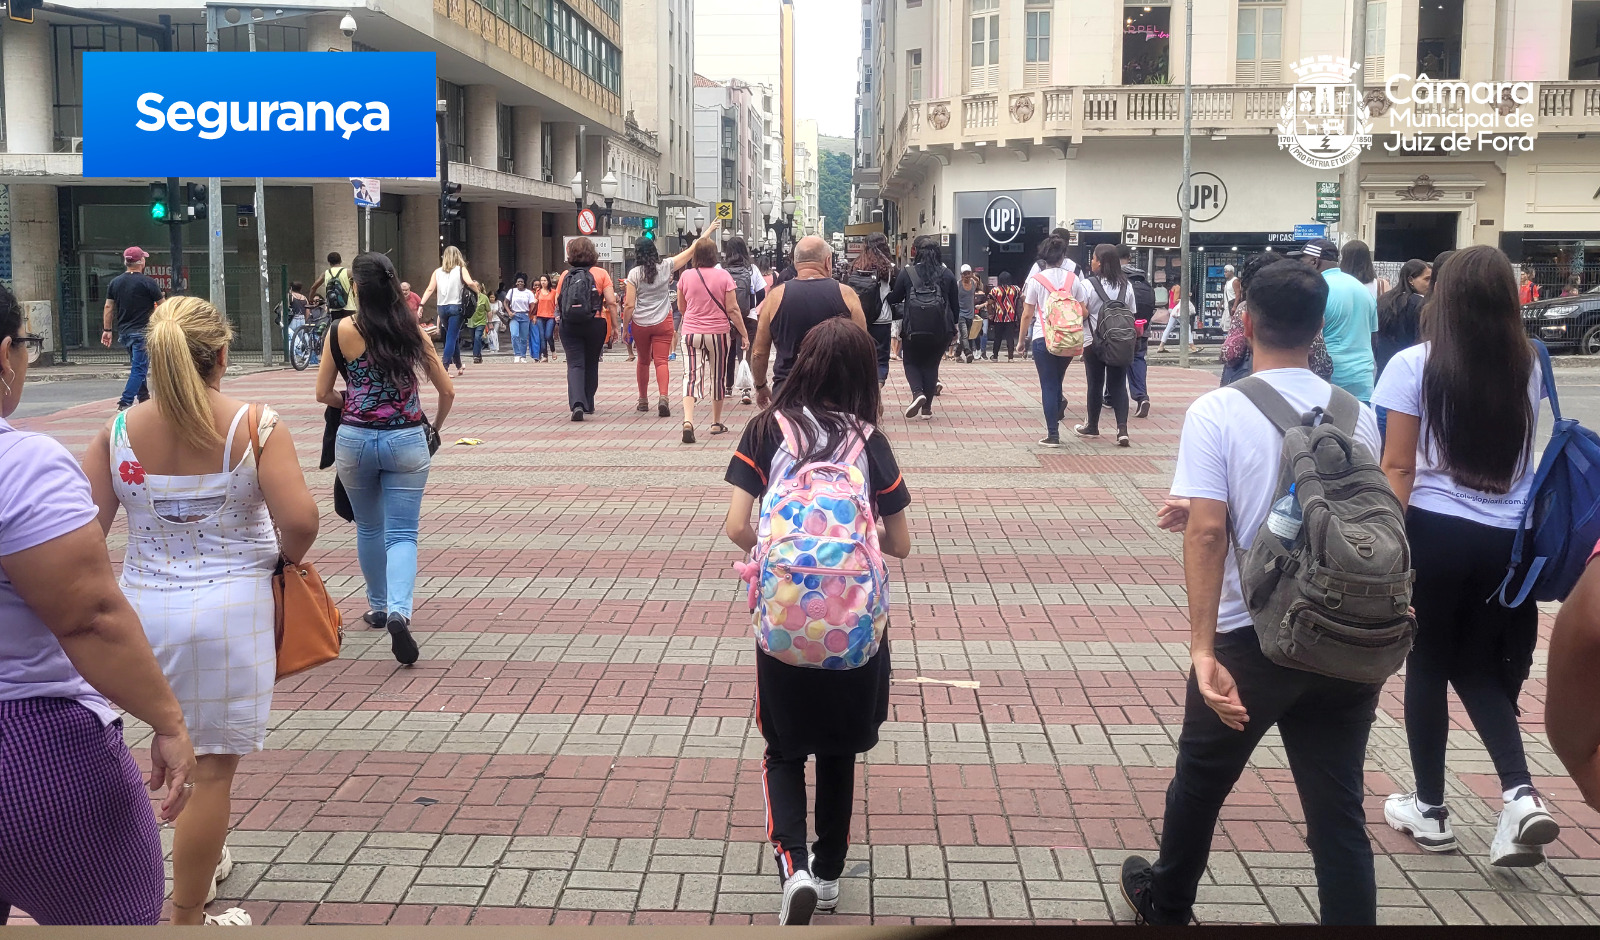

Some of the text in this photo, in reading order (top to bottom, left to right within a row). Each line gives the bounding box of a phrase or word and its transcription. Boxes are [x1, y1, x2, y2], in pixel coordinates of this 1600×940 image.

[1189, 184, 1219, 210] UP!
[644, 218, 654, 229] 31
[990, 207, 1015, 232] UP!
[1141, 220, 1177, 230] Parque
[1140, 235, 1177, 243] Halfeld
[144, 267, 172, 275] ALUG
